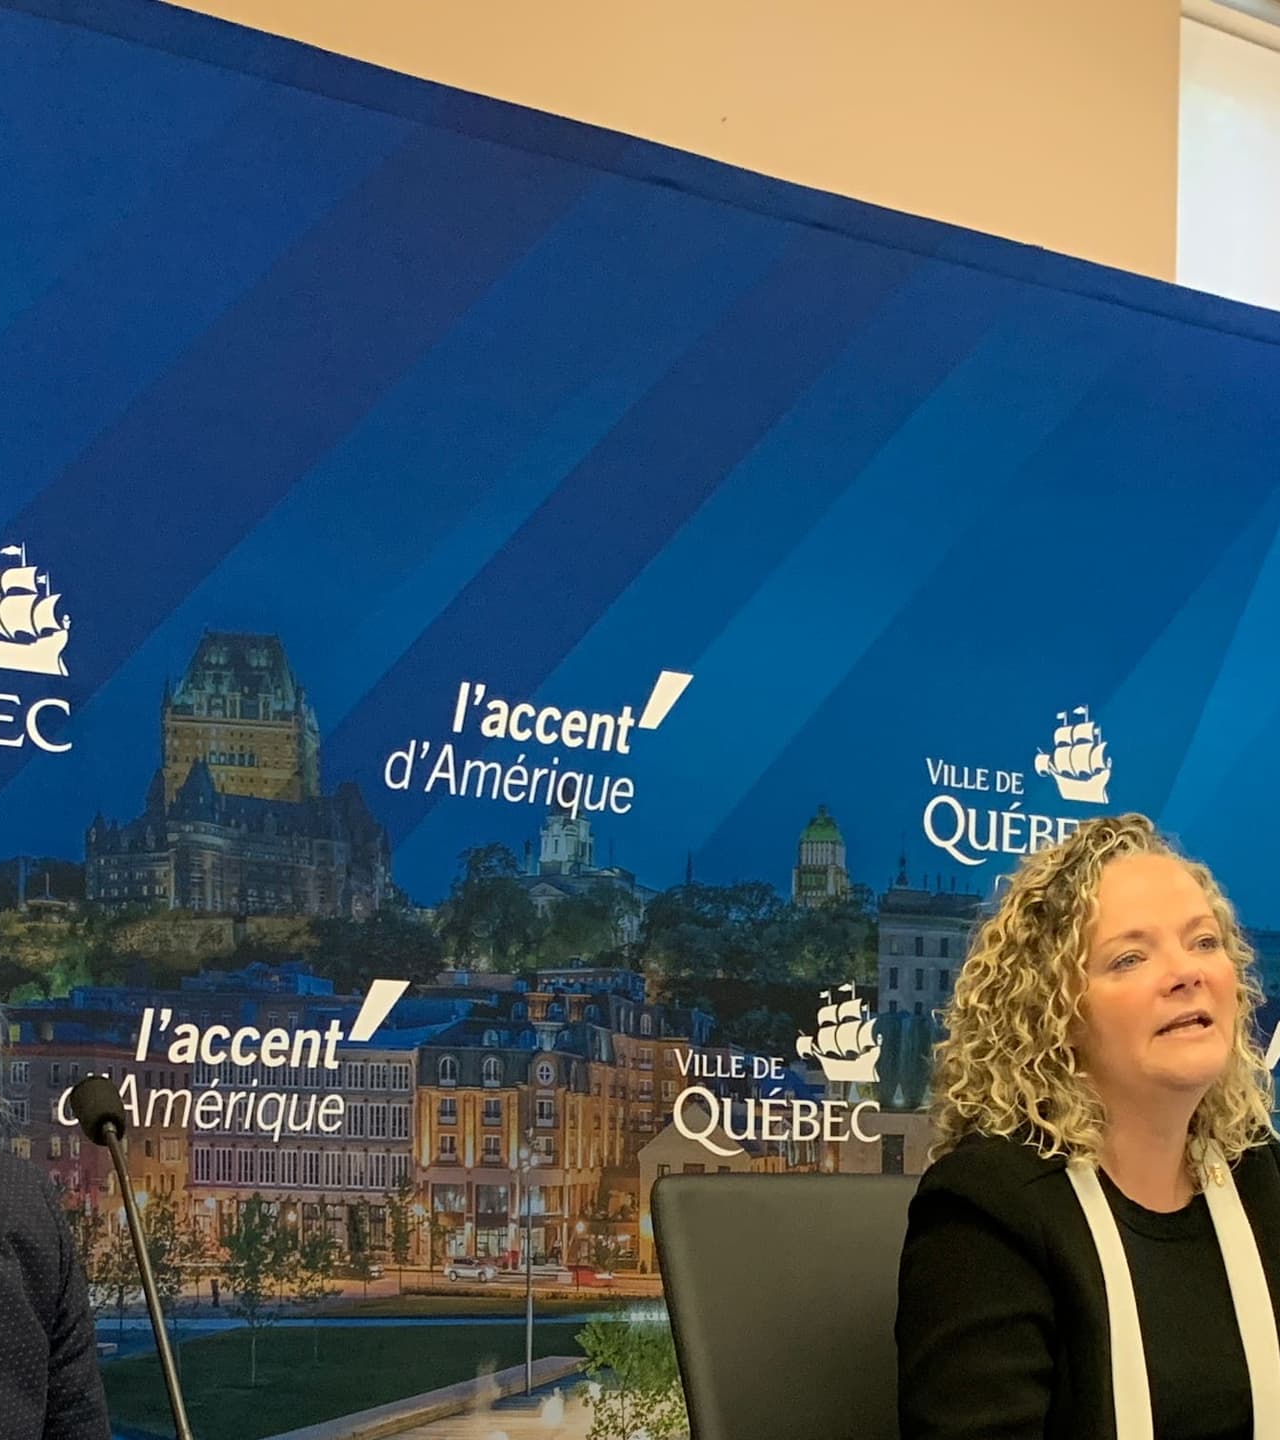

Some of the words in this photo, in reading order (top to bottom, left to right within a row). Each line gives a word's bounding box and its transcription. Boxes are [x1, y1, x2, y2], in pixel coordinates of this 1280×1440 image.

[452, 681, 636, 755] l'accent
[384, 739, 635, 821] d'Amérique
[925, 757, 989, 791] VILLE
[996, 770, 1024, 795] DE
[923, 795, 1081, 867] QUÉBE
[135, 1007, 345, 1070] l'accent
[673, 1048, 746, 1079] VILLE
[753, 1056, 785, 1080] DE
[57, 1072, 345, 1143] Amérique
[673, 1086, 882, 1157] QUÉBEC
